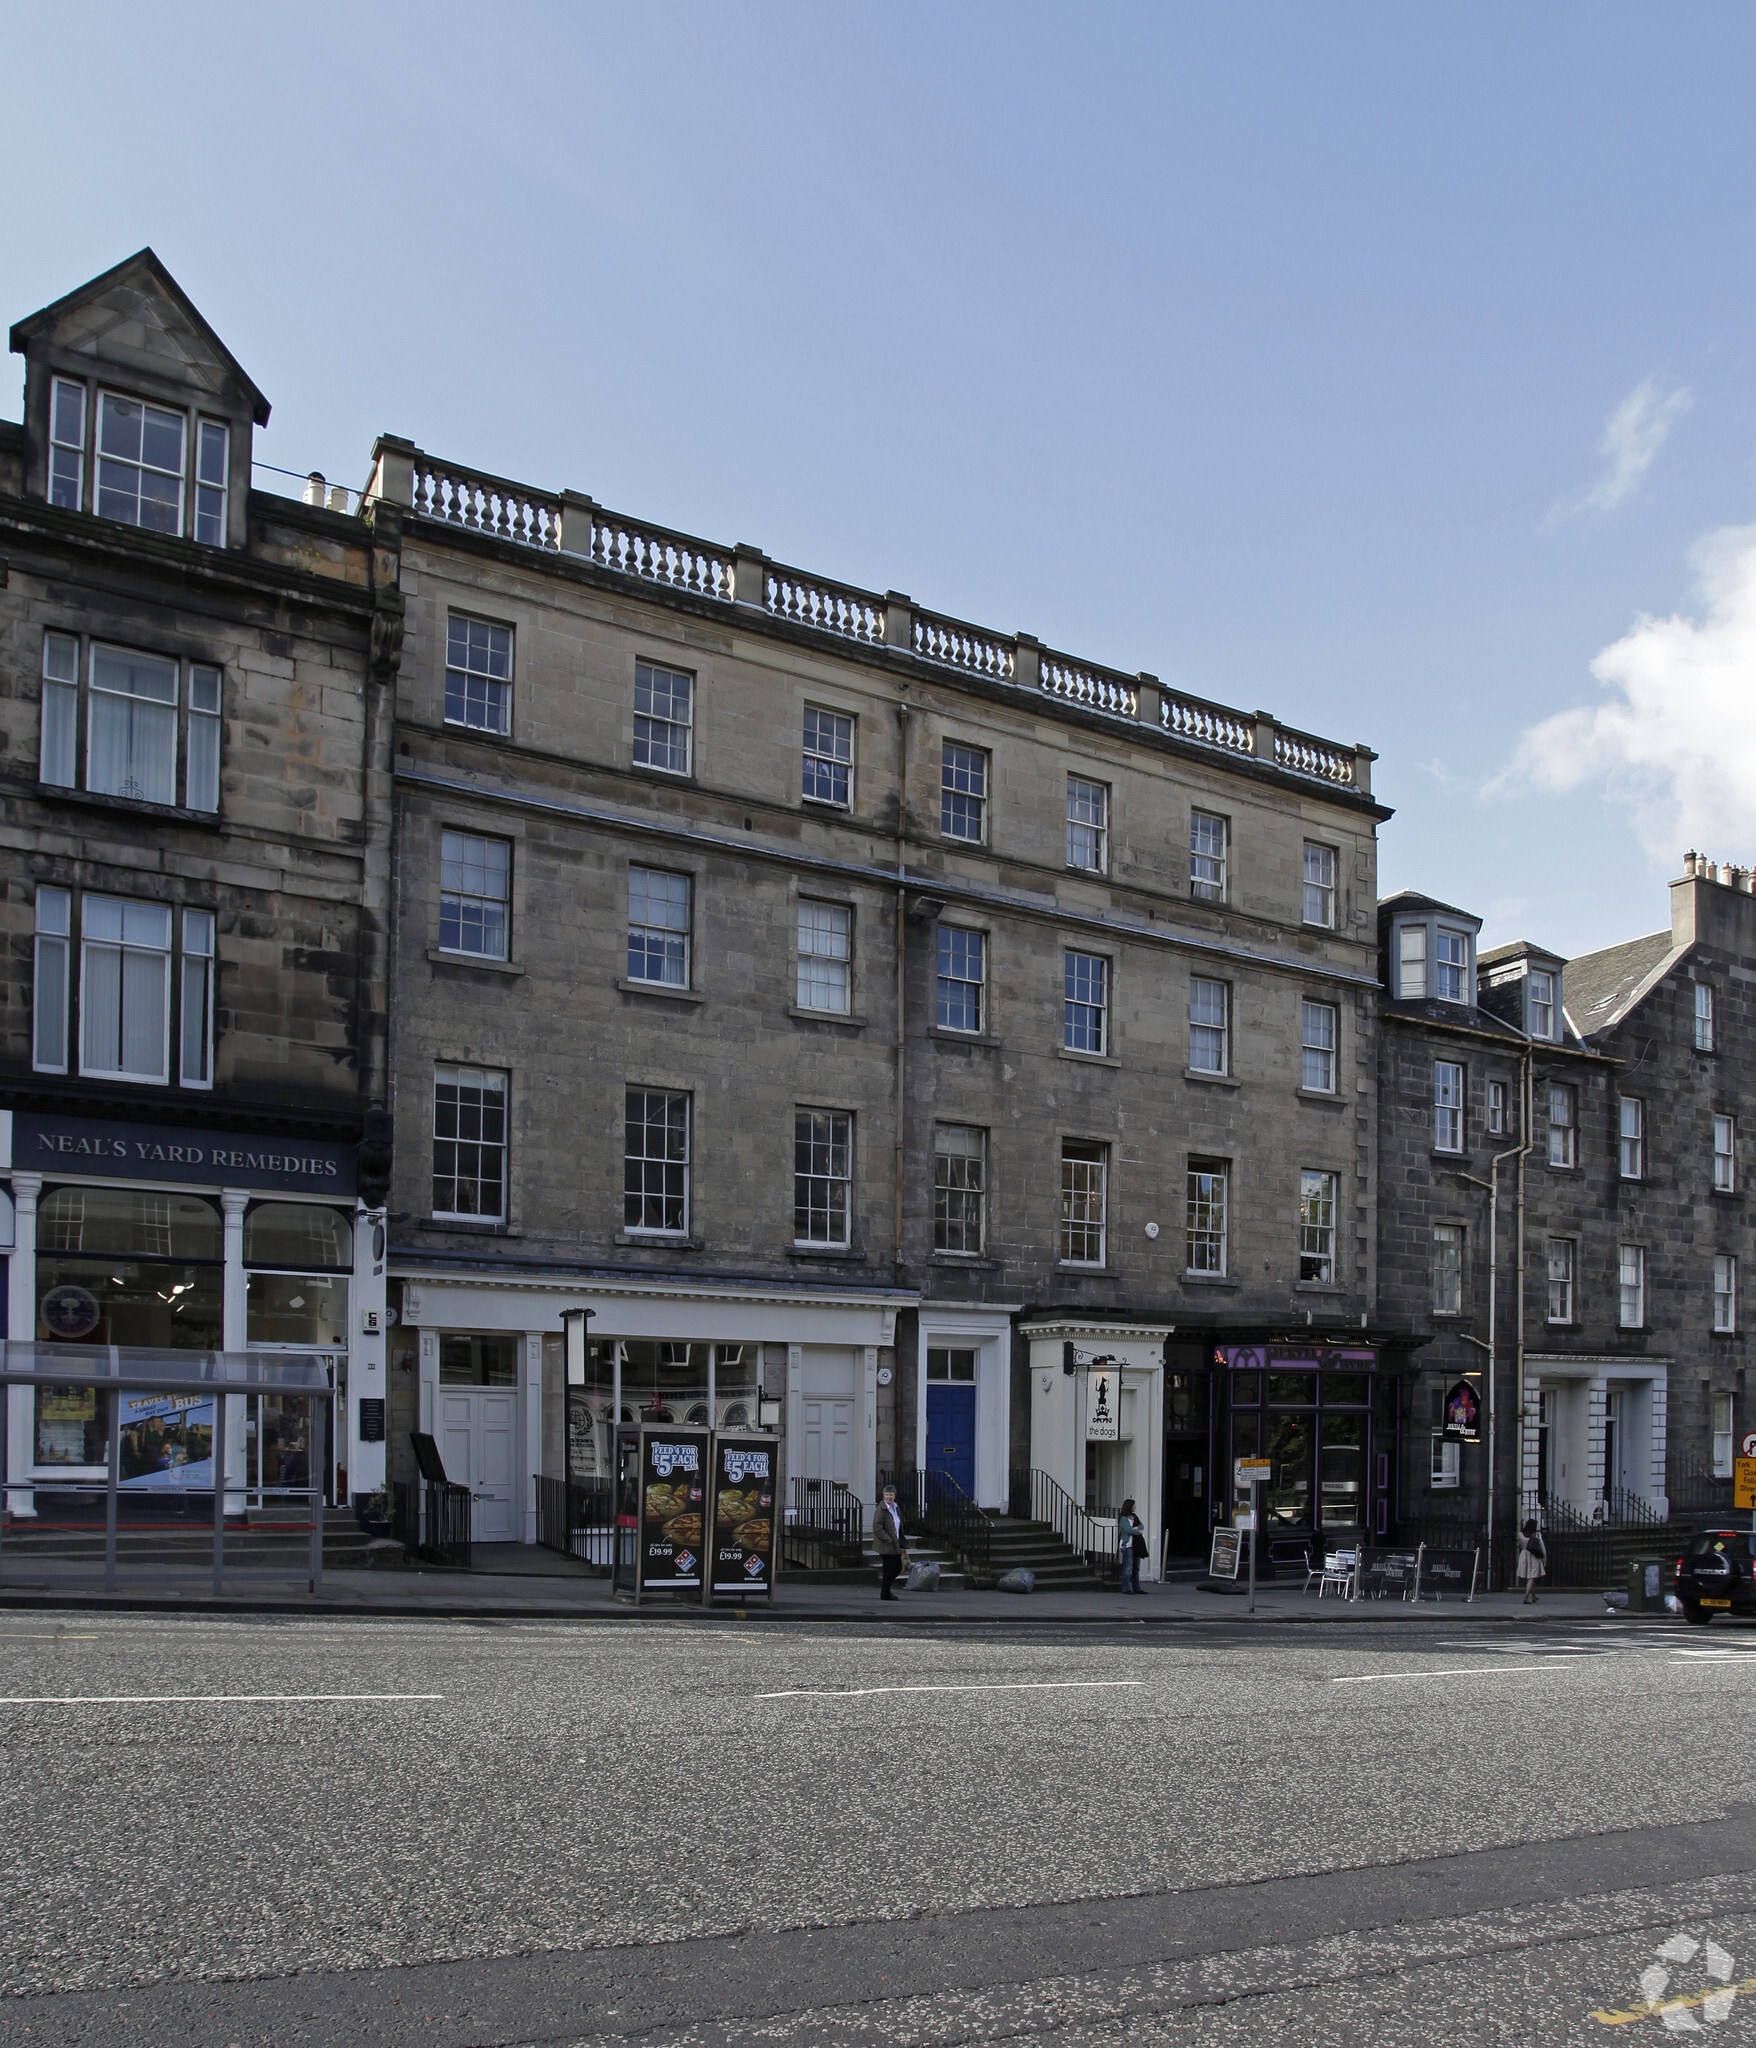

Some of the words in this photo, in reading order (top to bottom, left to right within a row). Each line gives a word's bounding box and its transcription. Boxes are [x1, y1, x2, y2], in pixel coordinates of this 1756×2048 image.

[37, 1132, 127, 1158] NEAL'S
[135, 1142, 203, 1164] YARD
[211, 1149, 338, 1176] REMEDIES
[131, 1396, 165, 1409] TRAVEL
[175, 1394, 203, 1410] BUS
[139, 1404, 157, 1413] GREAT
[156, 1406, 169, 1414] OUT
[1089, 1426, 1099, 1436] the
[1100, 1426, 1116, 1439] dogs
[654, 1446, 673, 1455] FEED
[674, 1447, 680, 1455] 4
[681, 1447, 696, 1456] FOR
[727, 1453, 745, 1461] FEED
[746, 1453, 752, 1461] 4
[753, 1454, 767, 1462] FOR
[654, 1455, 671, 1475] £5
[671, 1454, 697, 1465] EACH
[727, 1460, 742, 1481] £5
[743, 1460, 766, 1471] EACH
[649, 1547, 673, 1556] £19.99
[719, 1552, 742, 1561] £19.99
[1694, 1568, 1727, 1576] SUZUKI
